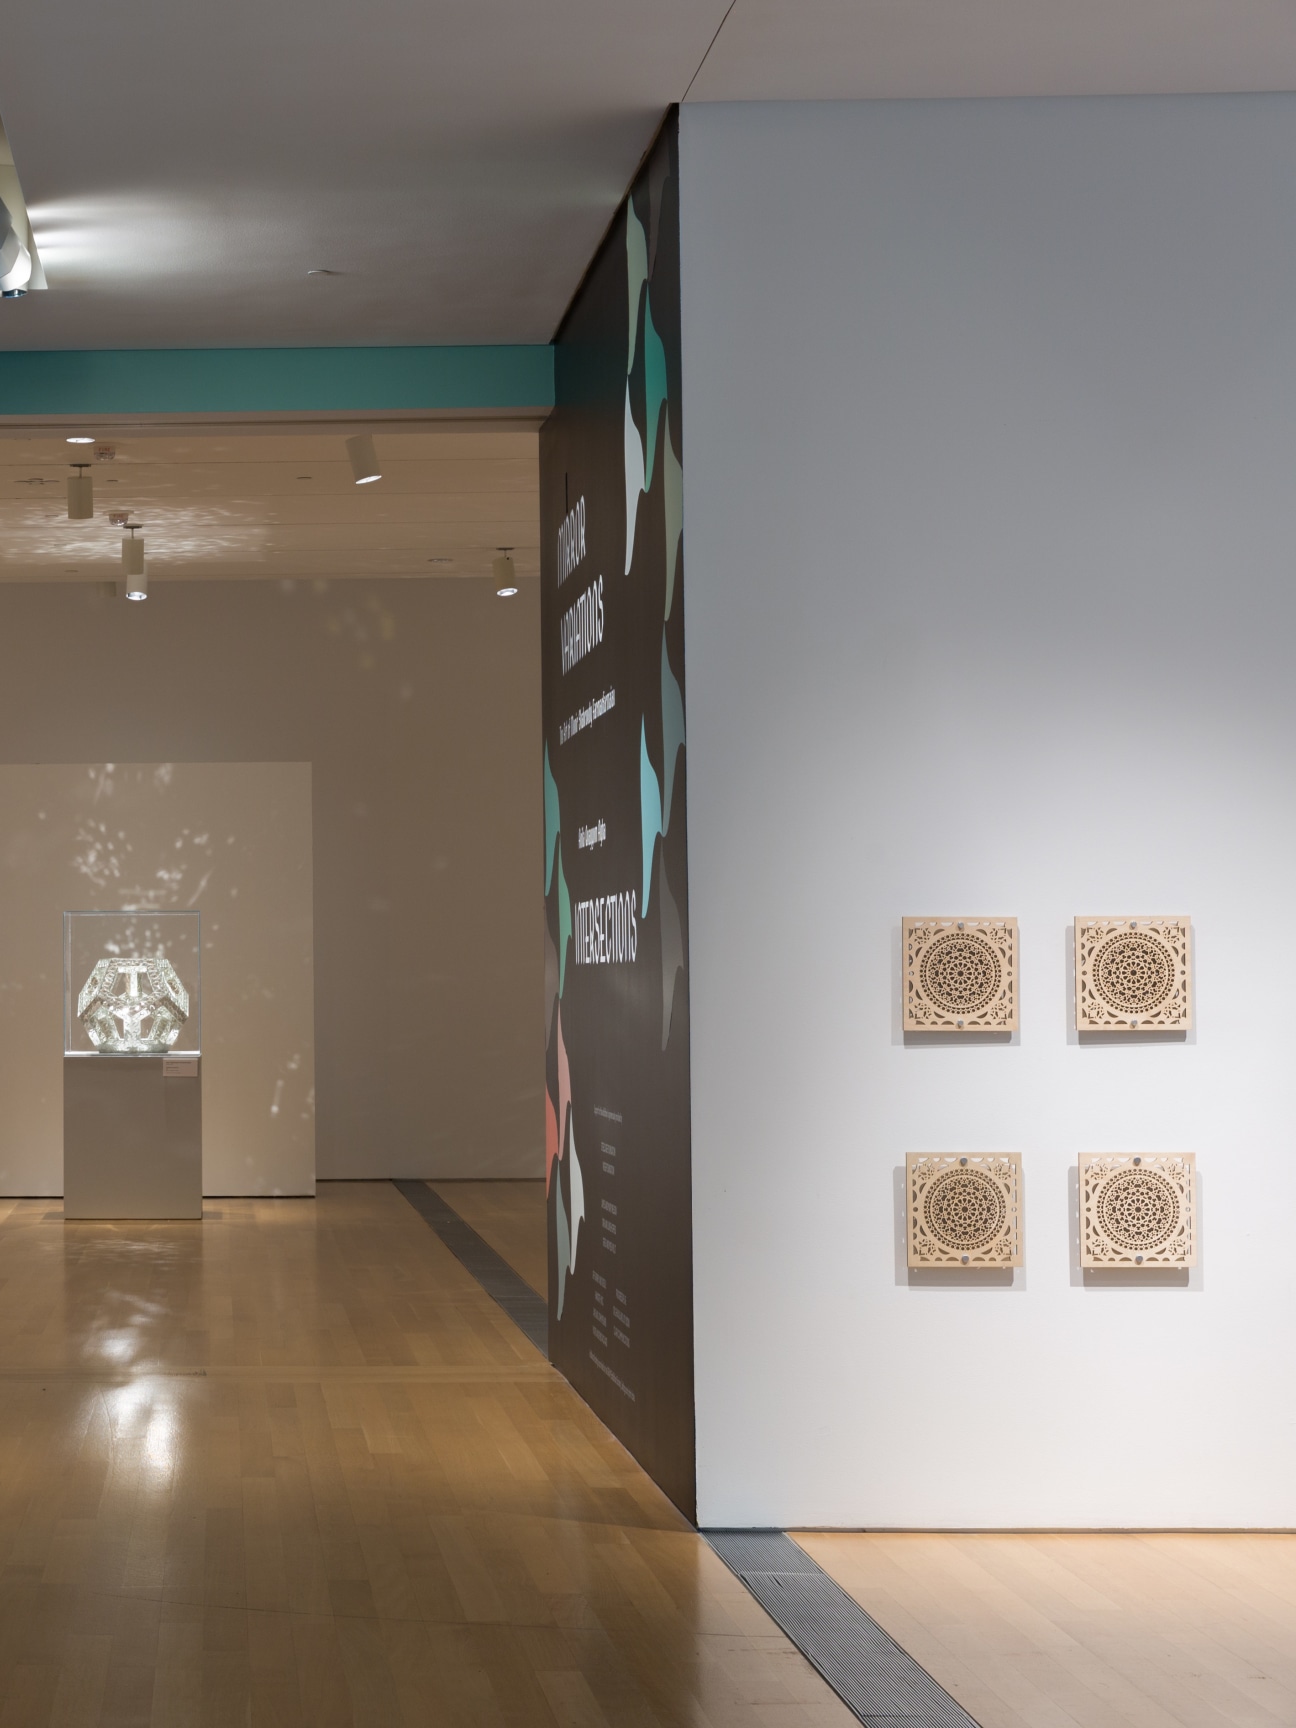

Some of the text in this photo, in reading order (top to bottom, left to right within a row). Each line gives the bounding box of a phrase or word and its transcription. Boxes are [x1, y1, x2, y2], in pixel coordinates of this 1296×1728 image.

[557, 495, 586, 589] MIRROR
[560, 574, 604, 676] VARIATIONS
[574, 889, 638, 965] INTERSECTIONS
